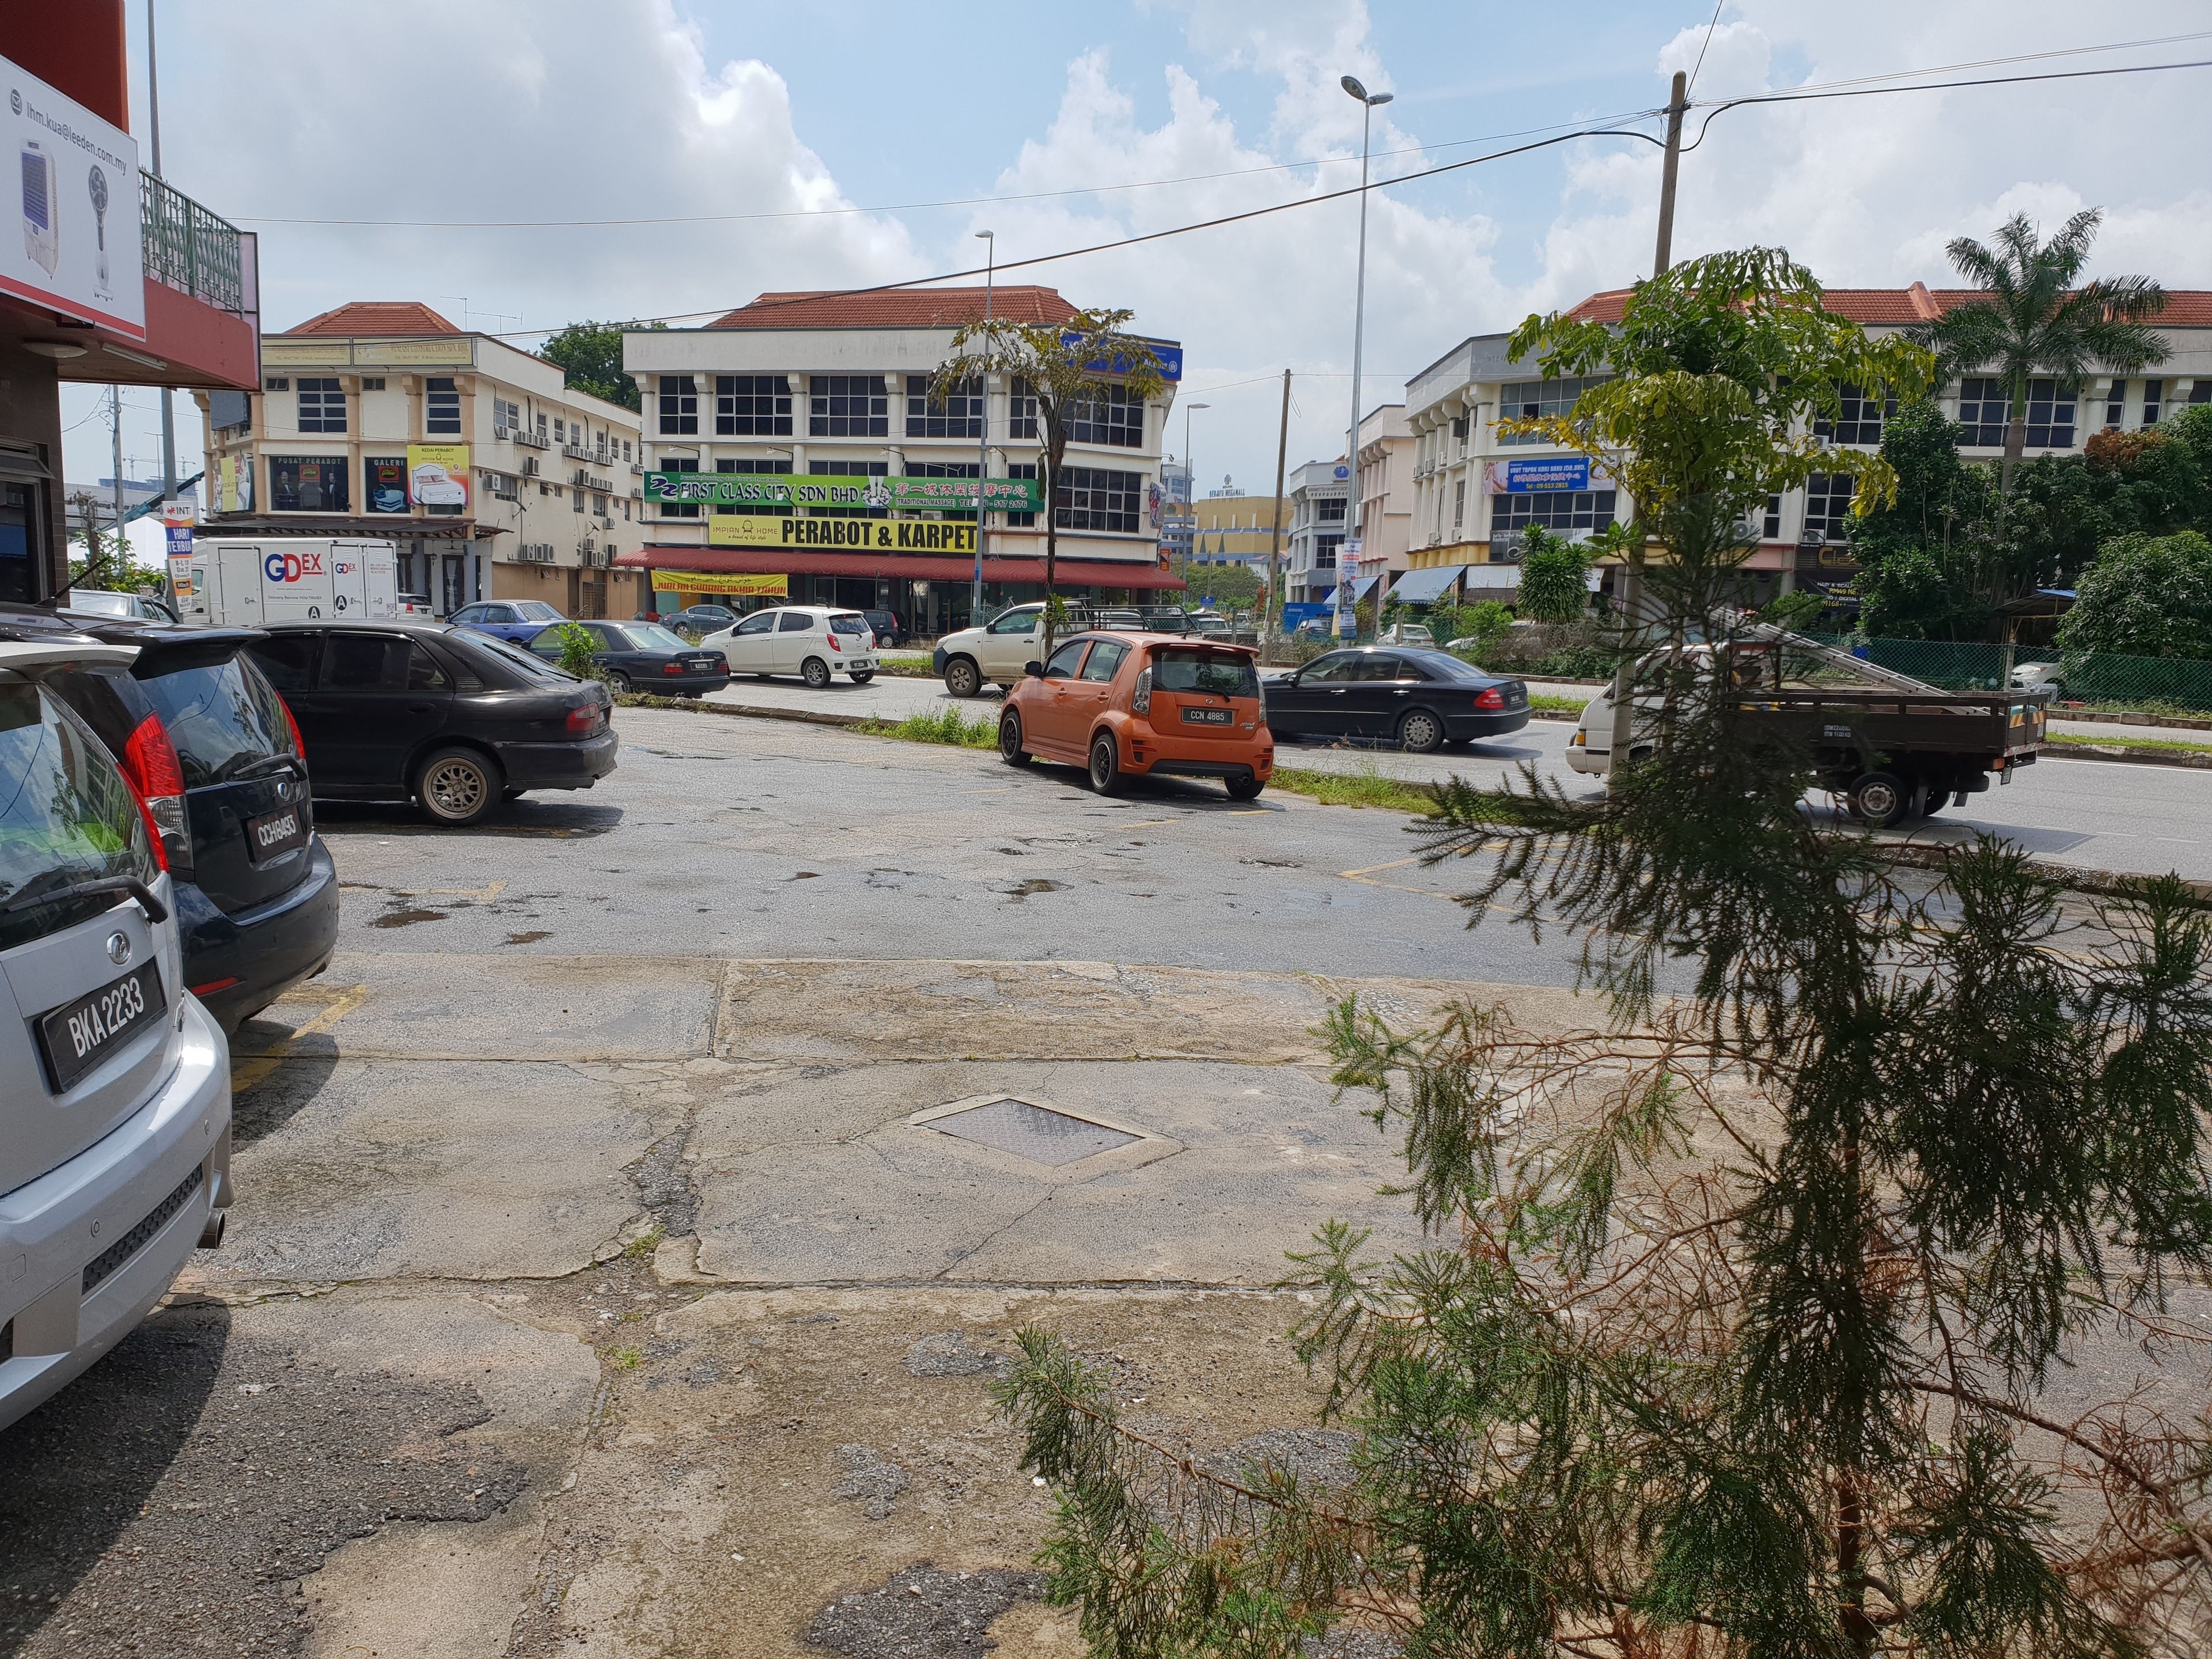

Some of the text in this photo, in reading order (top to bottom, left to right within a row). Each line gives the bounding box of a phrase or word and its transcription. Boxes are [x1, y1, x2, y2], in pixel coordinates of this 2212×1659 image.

[681, 483, 858, 503] FIRST CLASS CITY SDN BHD
[930, 498, 956, 507] MASSAGE)
[173, 528, 190, 540] HARI
[782, 520, 978, 550] PERABOT & KARPET
[264, 553, 323, 582] GDEX
[335, 563, 357, 574] GDEX
[654, 582, 689, 590] JUALAN
[727, 585, 755, 593] AKHIR
[756, 586, 786, 594] TAHUN
[337, 595, 346, 609] A
[310, 607, 319, 619] A
[1191, 710, 1225, 721] CCN 4885
[67, 976, 144, 1059] BKA 2233
